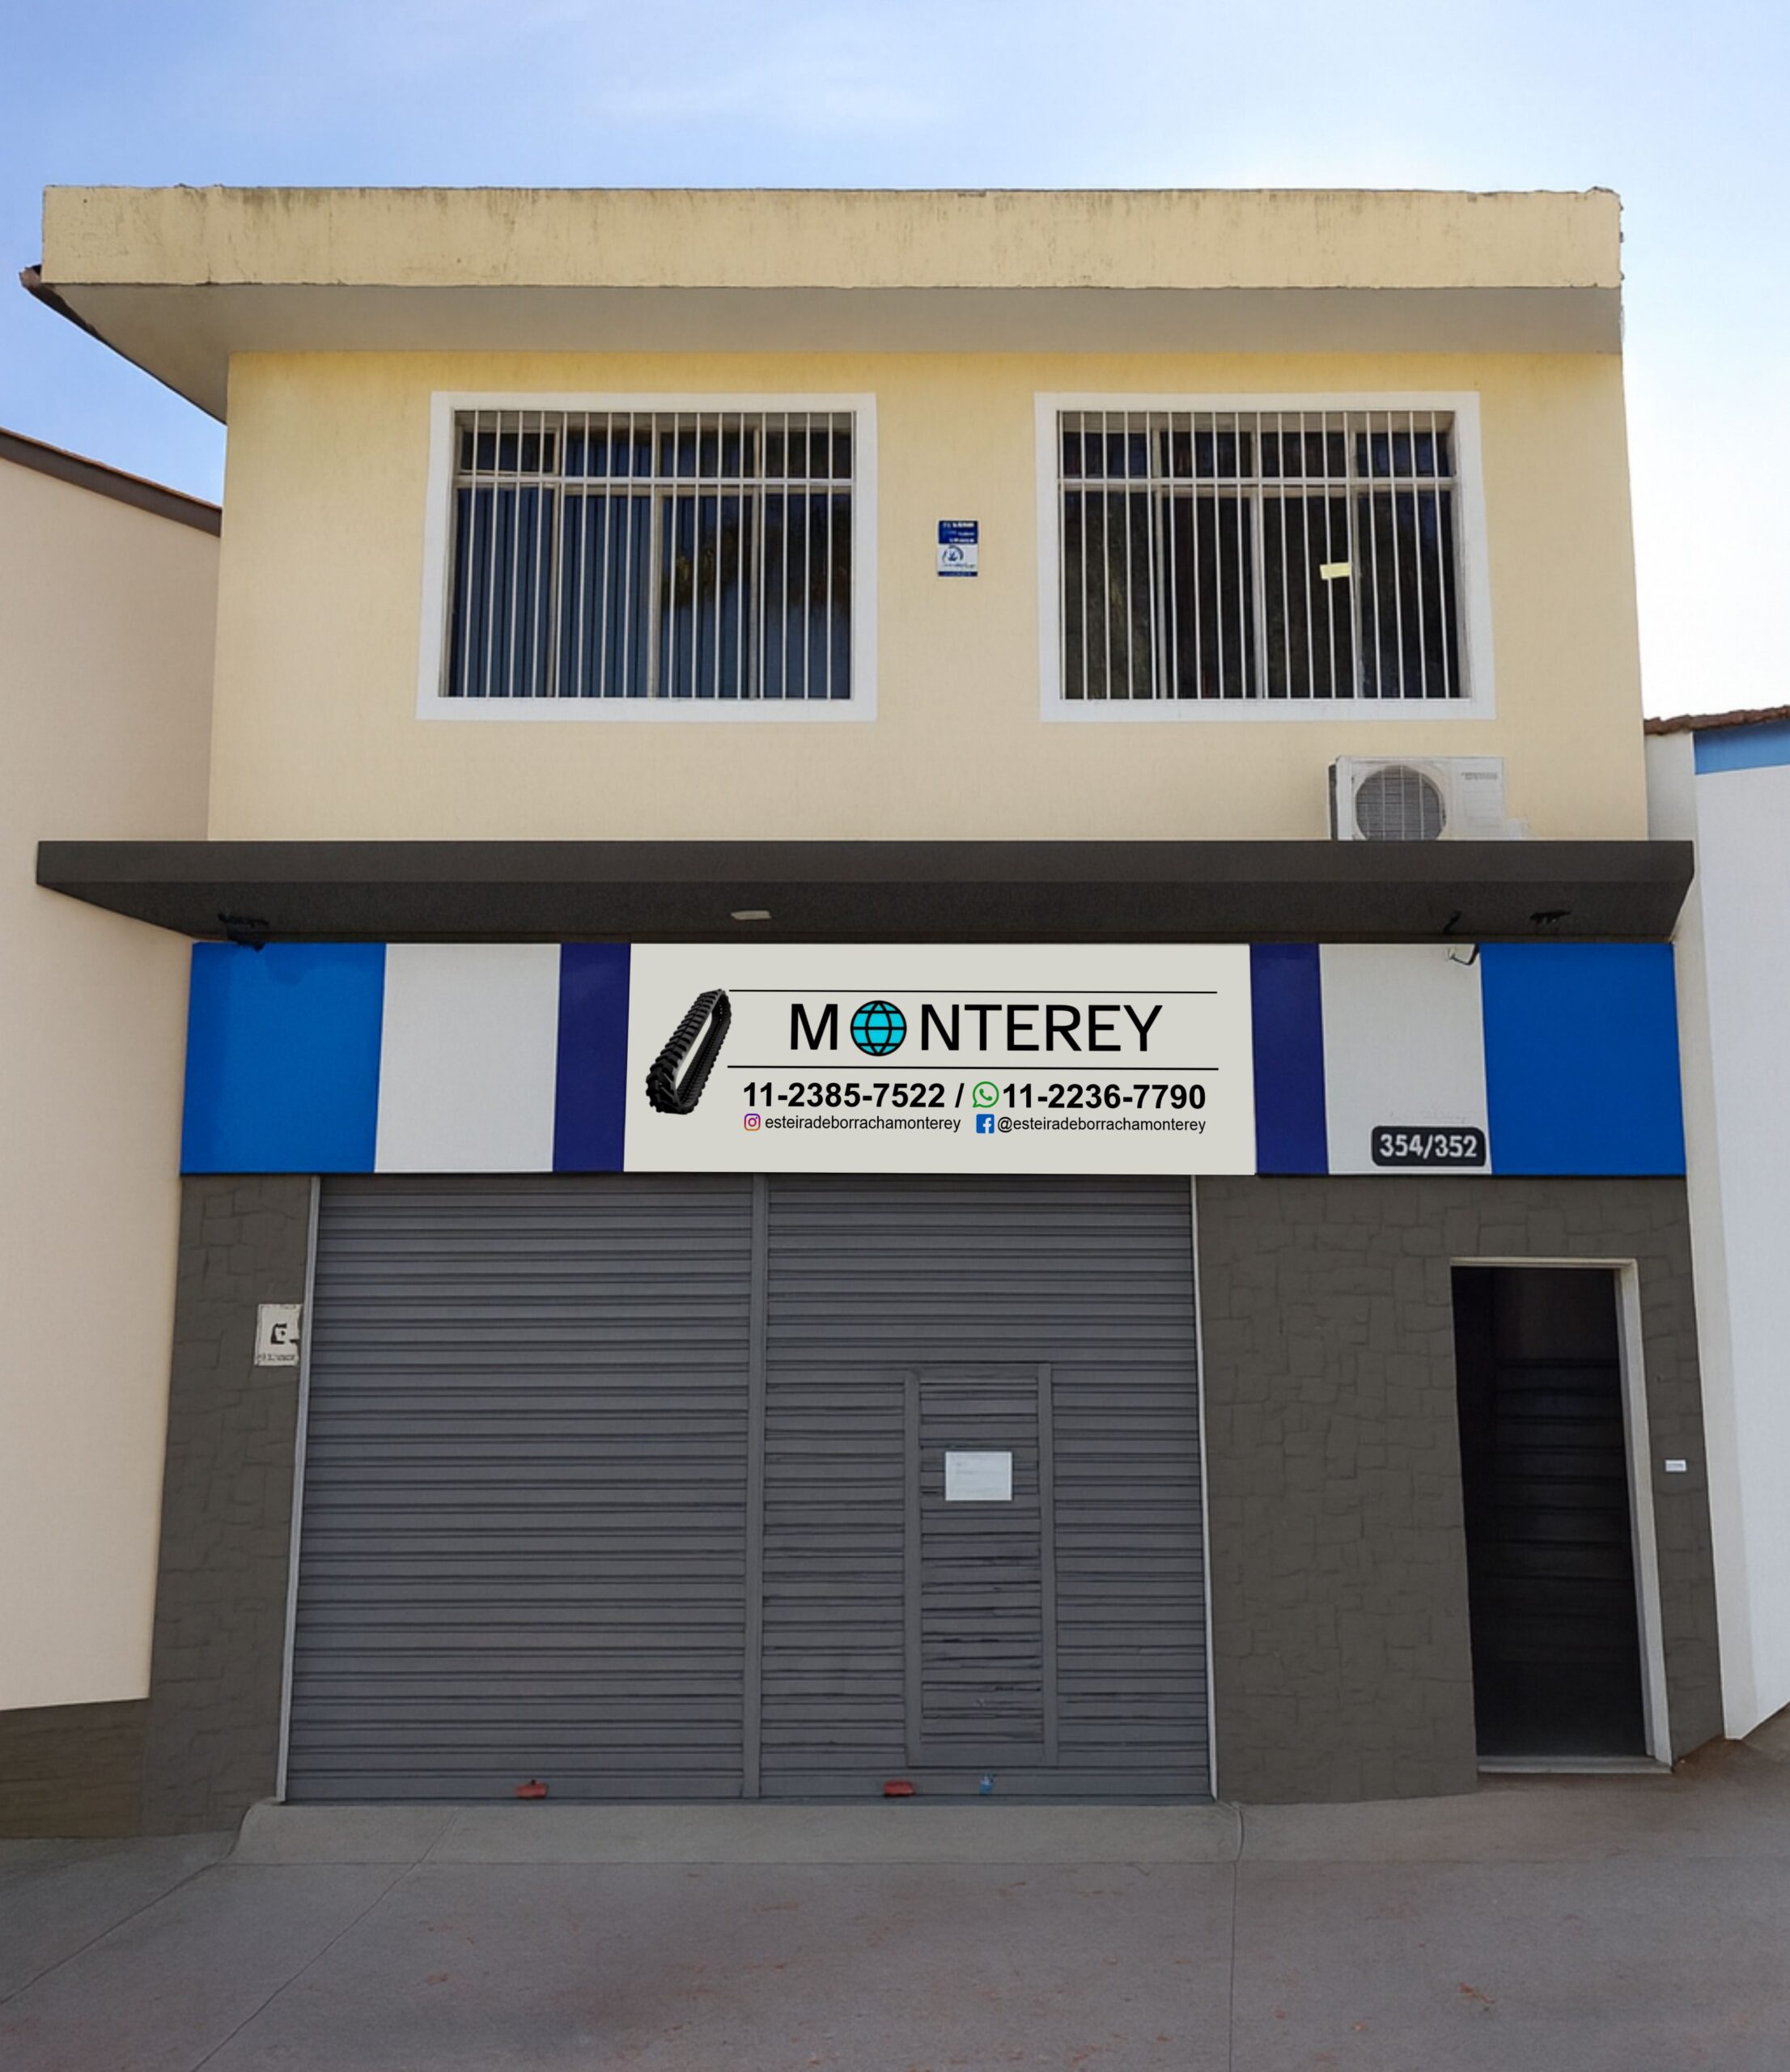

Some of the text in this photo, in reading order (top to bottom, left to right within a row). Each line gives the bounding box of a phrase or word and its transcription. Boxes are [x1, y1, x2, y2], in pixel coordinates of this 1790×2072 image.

[743, 1081, 946, 1109] 11-2385-7522
[1003, 1083, 1206, 1110] 11-2236-7790
[765, 1115, 1207, 1135] esteiradeborrachamonterey @esteiradeborrachamonterey
[1379, 1133, 1478, 1160] 354/352
